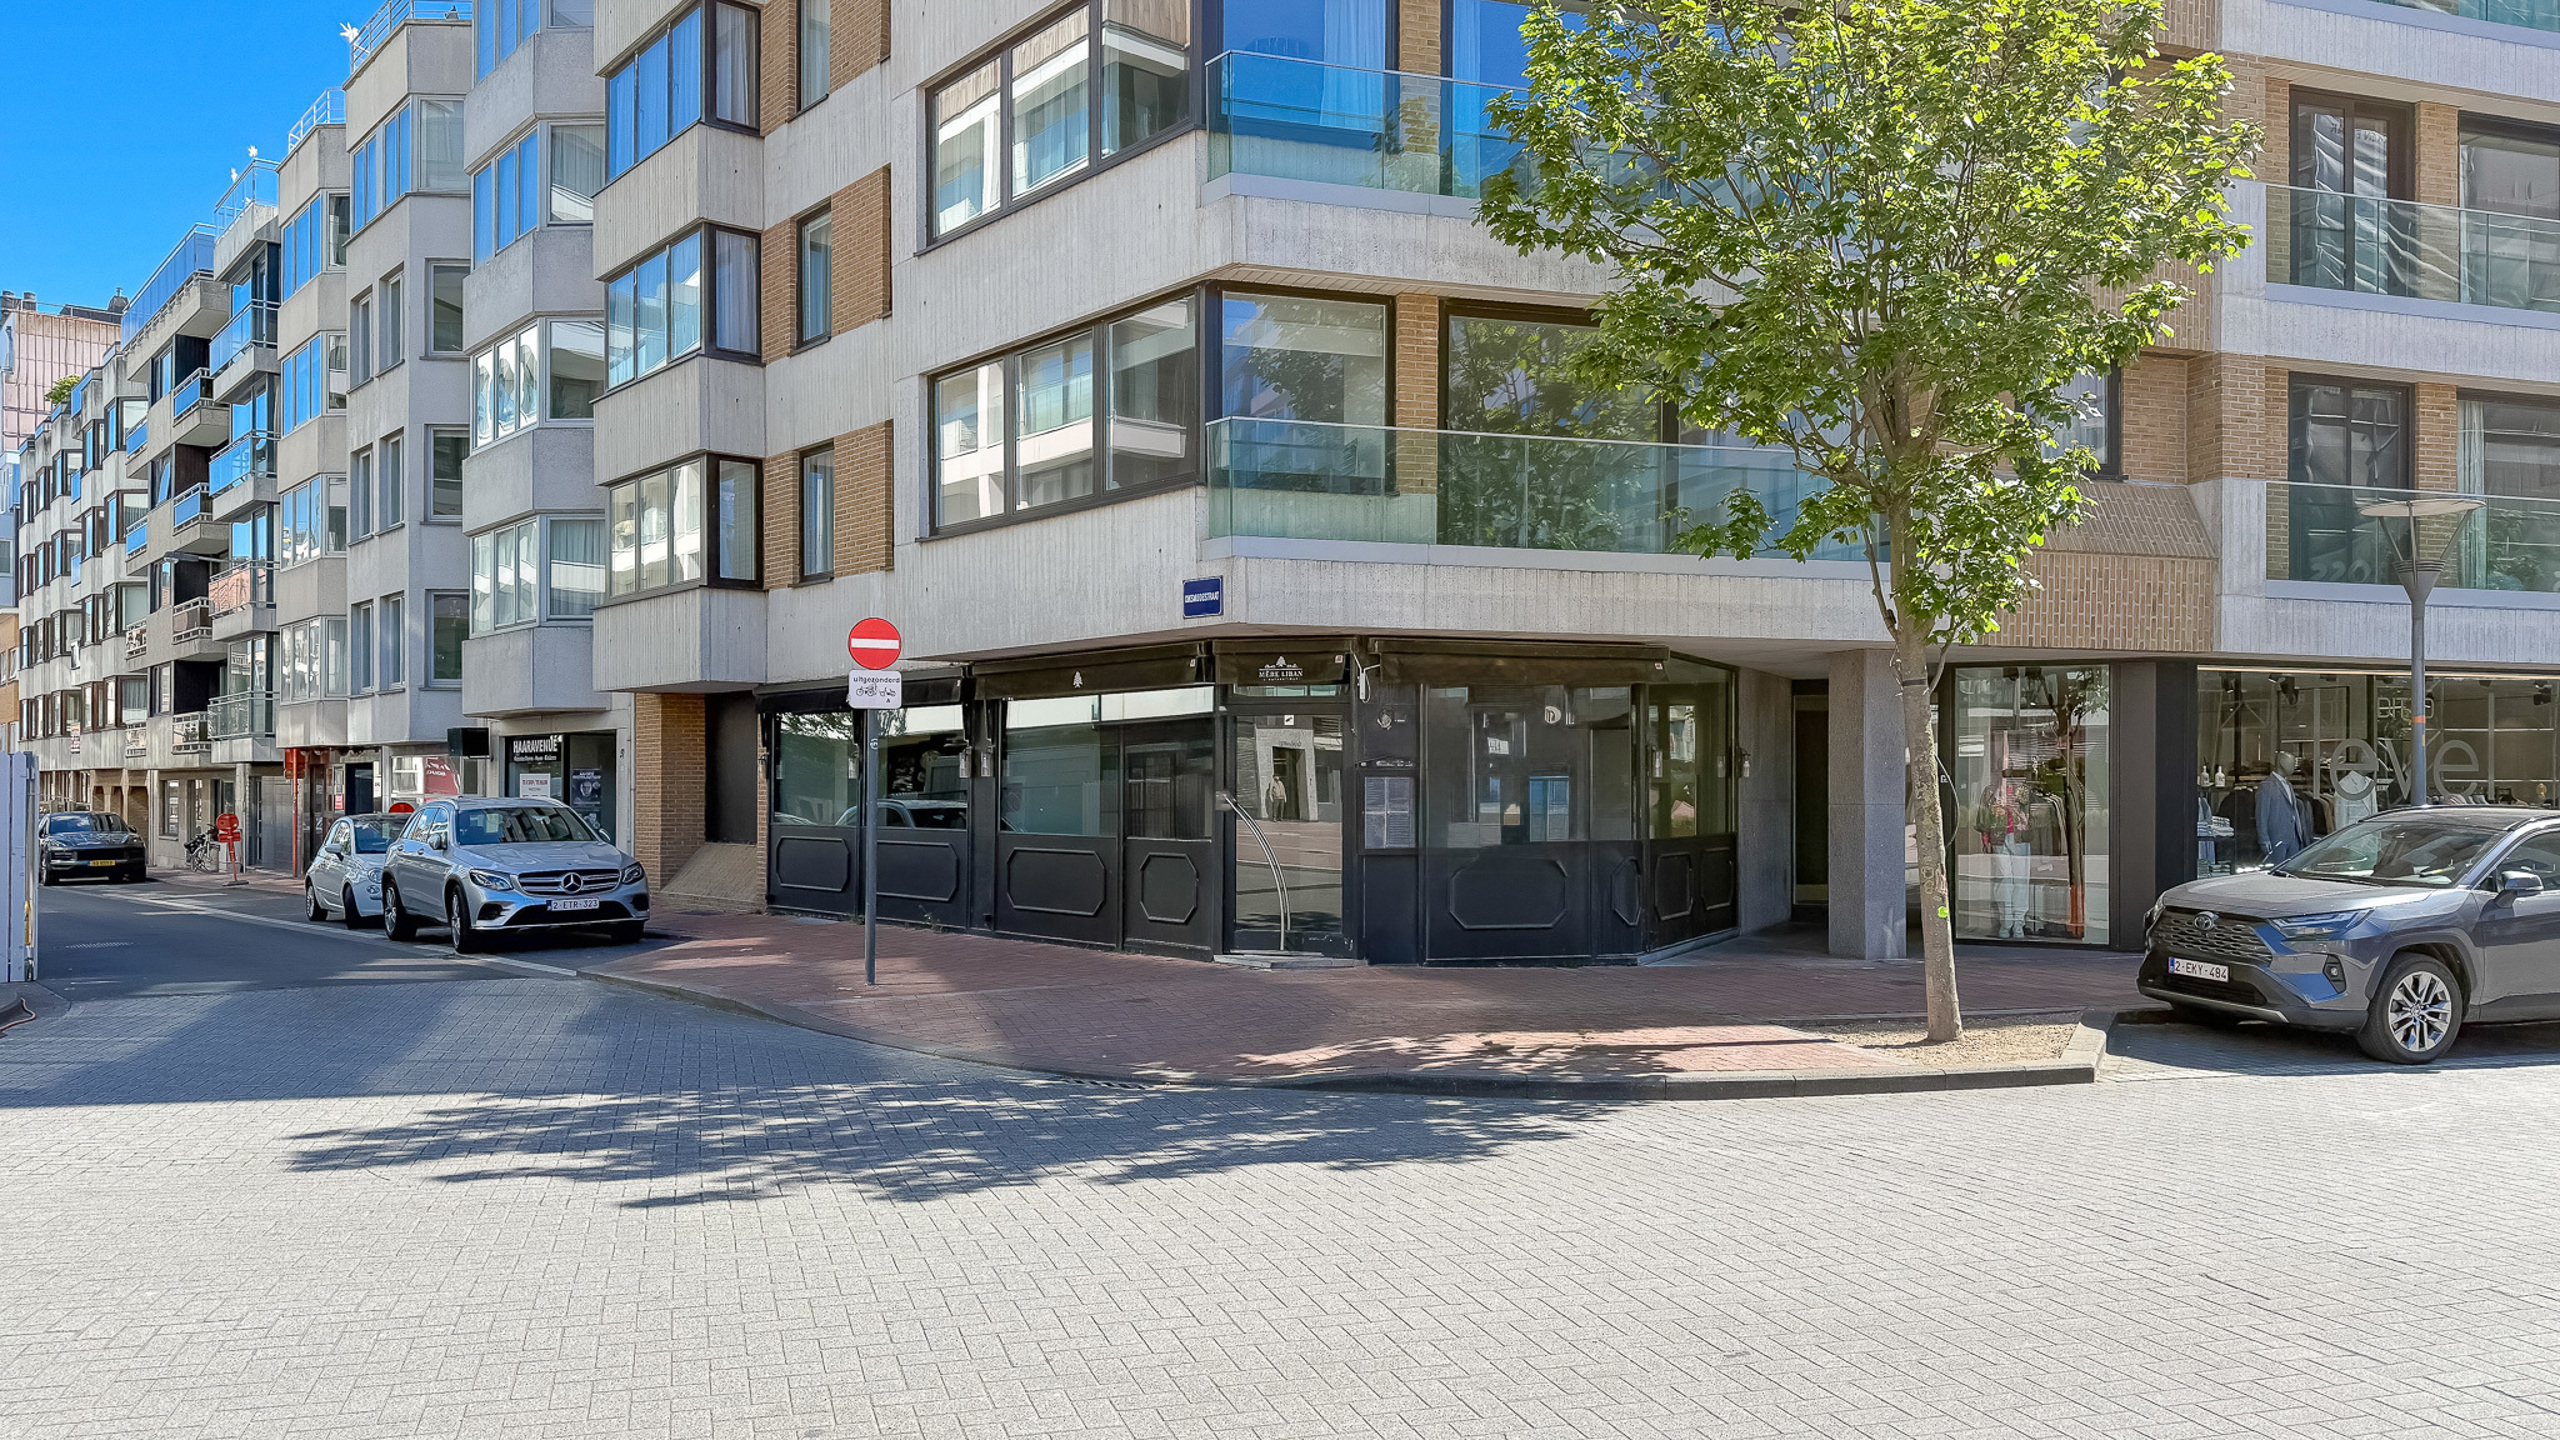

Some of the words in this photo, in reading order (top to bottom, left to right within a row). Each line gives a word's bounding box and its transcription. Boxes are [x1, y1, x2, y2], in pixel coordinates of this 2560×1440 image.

[853, 676, 901, 684] uitgezonderd
[513, 739, 559, 754] HAARAVENUE
[553, 900, 598, 910] 2-ETR-323
[2175, 960, 2227, 980] 2-EKY-484
